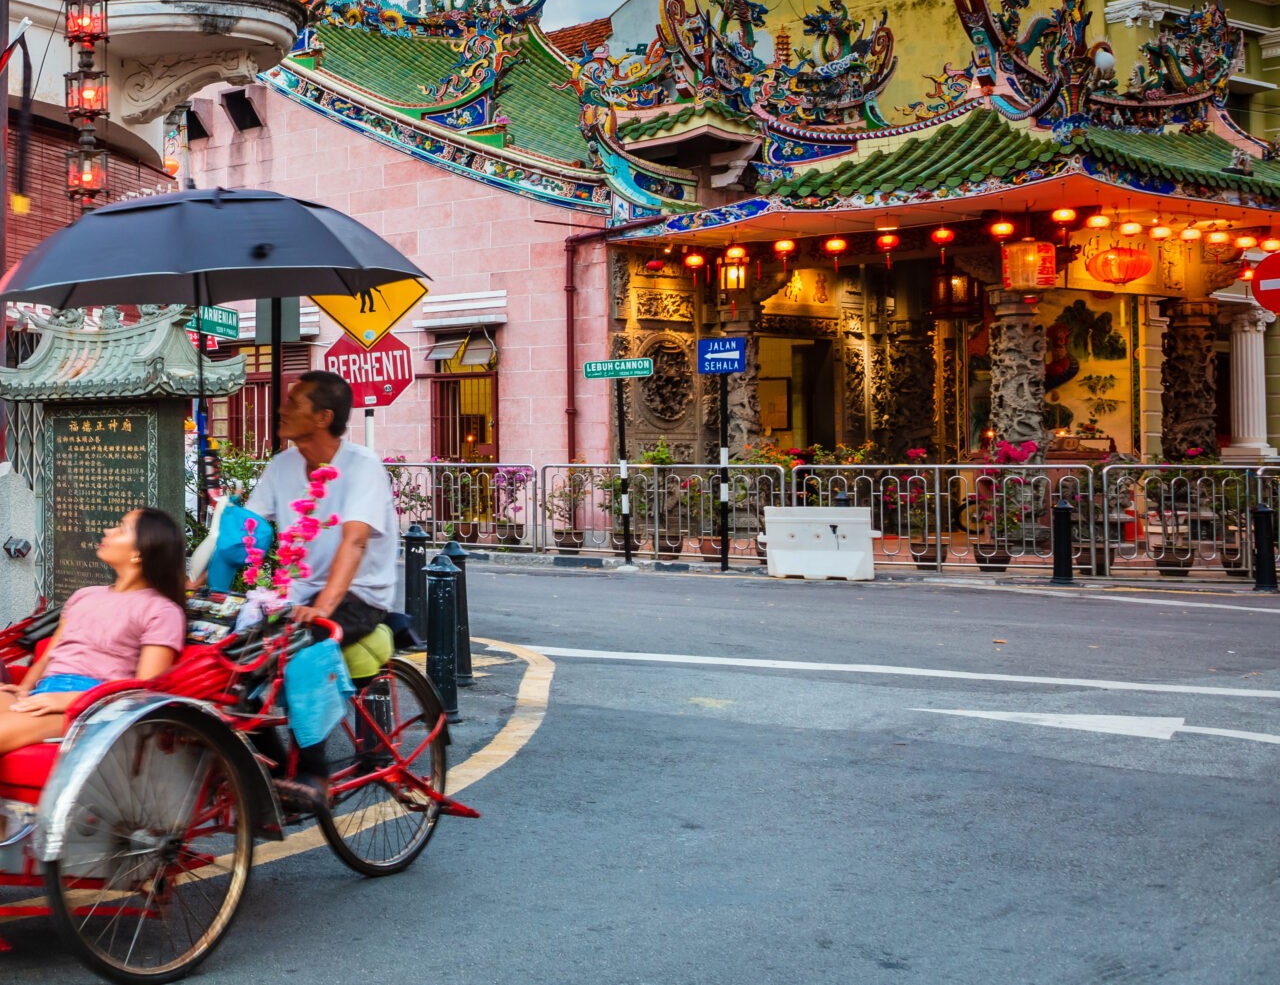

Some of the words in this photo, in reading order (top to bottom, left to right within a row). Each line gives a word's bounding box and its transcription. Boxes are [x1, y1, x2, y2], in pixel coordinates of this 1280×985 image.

[203, 307, 237, 326] ARMENIAN
[708, 341, 737, 351] JALAN
[328, 350, 409, 384] BERHENTI
[586, 362, 613, 372] LEBUH
[614, 360, 650, 371] CANNON
[704, 361, 739, 371] SEHALA
